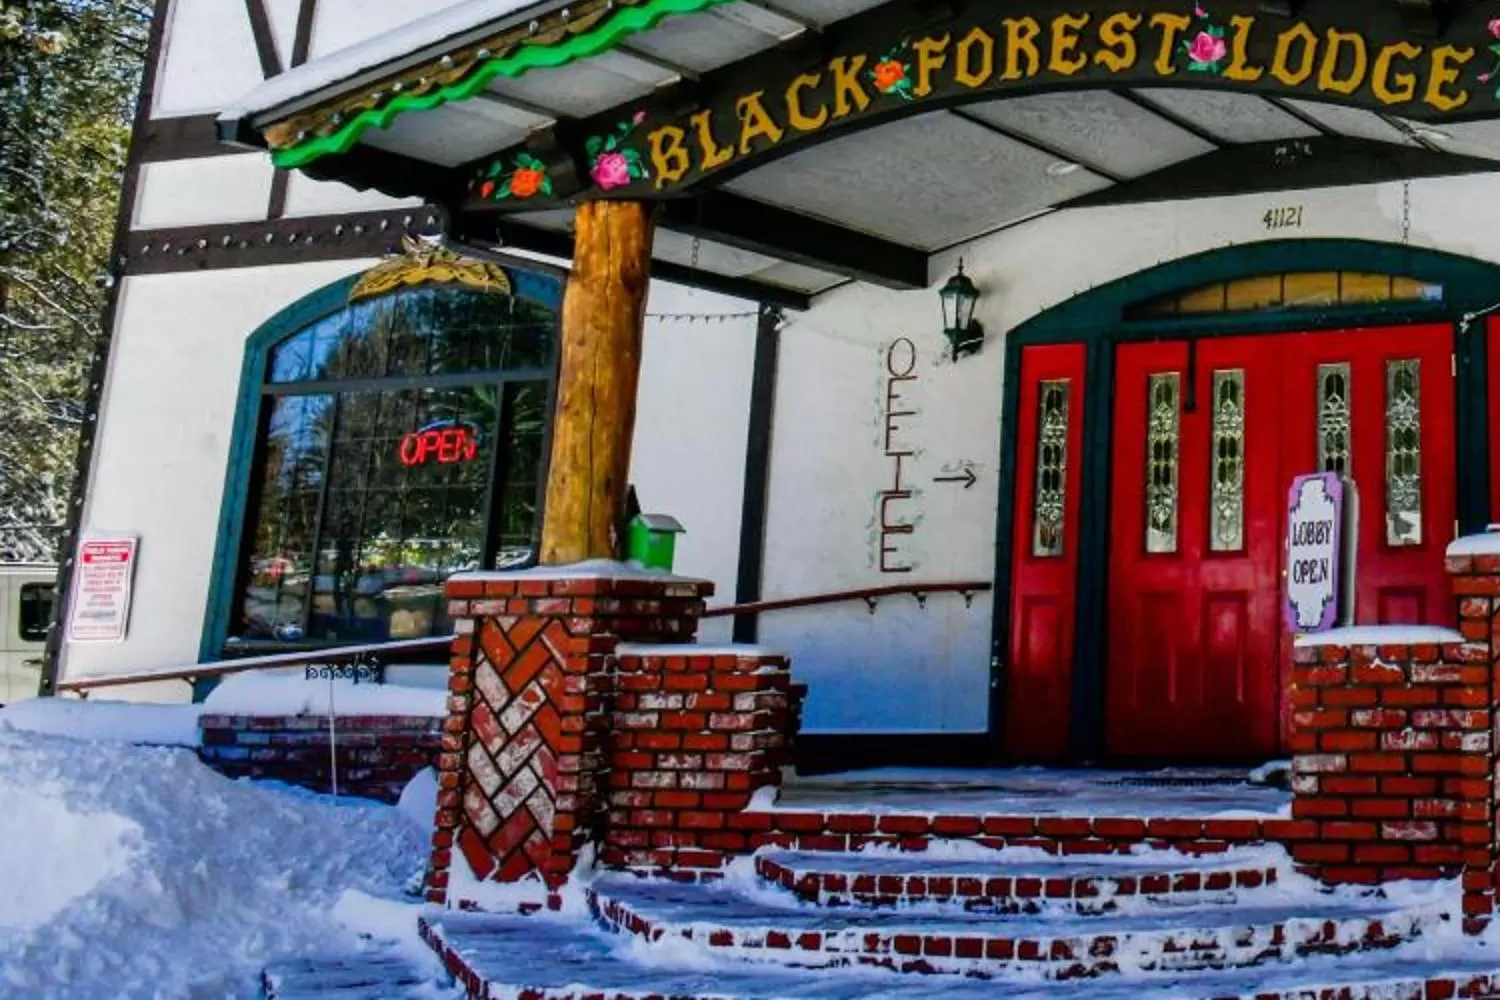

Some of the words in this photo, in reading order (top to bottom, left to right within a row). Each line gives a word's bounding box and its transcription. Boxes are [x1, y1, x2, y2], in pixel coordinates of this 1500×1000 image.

[648, 53, 871, 190] BLACK
[912, 12, 1190, 98] FOREST
[1221, 15, 1474, 111] LODGE
[1263, 204, 1303, 229] 41121
[400, 428, 478, 465] OPEN
[877, 336, 918, 574] OFFICE
[1292, 519, 1333, 547] LOBBY
[1293, 557, 1329, 585] OPEN
